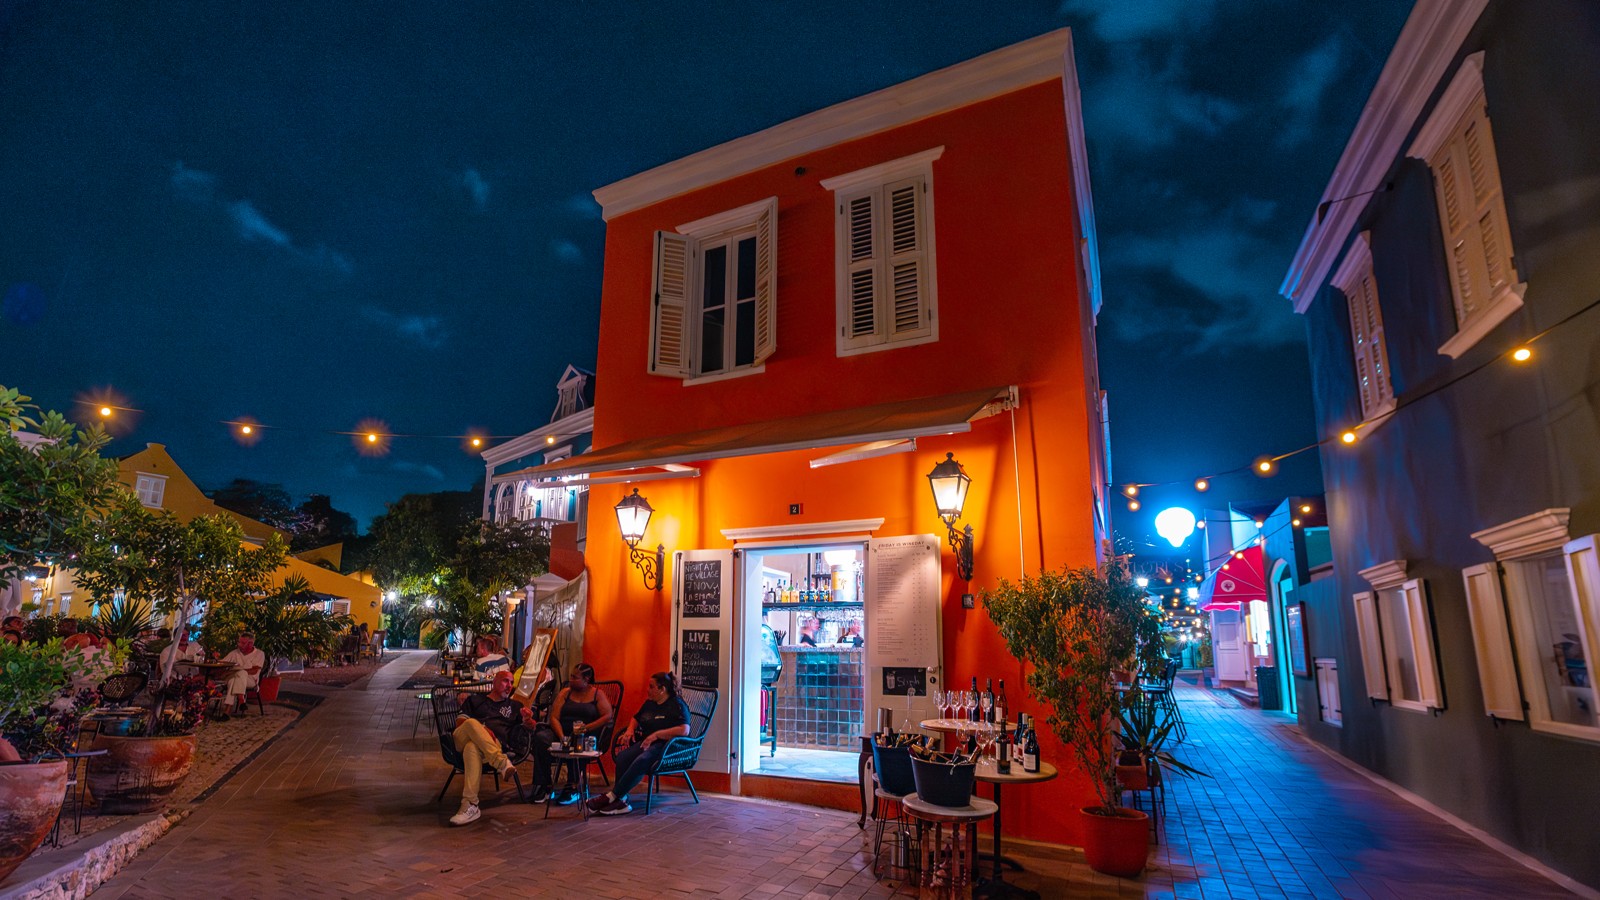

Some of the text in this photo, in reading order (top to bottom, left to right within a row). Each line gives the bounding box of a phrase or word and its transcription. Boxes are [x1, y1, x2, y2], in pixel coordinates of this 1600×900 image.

[685, 562, 716, 573] NIGHT AT
[694, 569, 719, 579] VILLAGE
[686, 581, 715, 591] 7 NOV
[689, 632, 710, 643] LIVE
